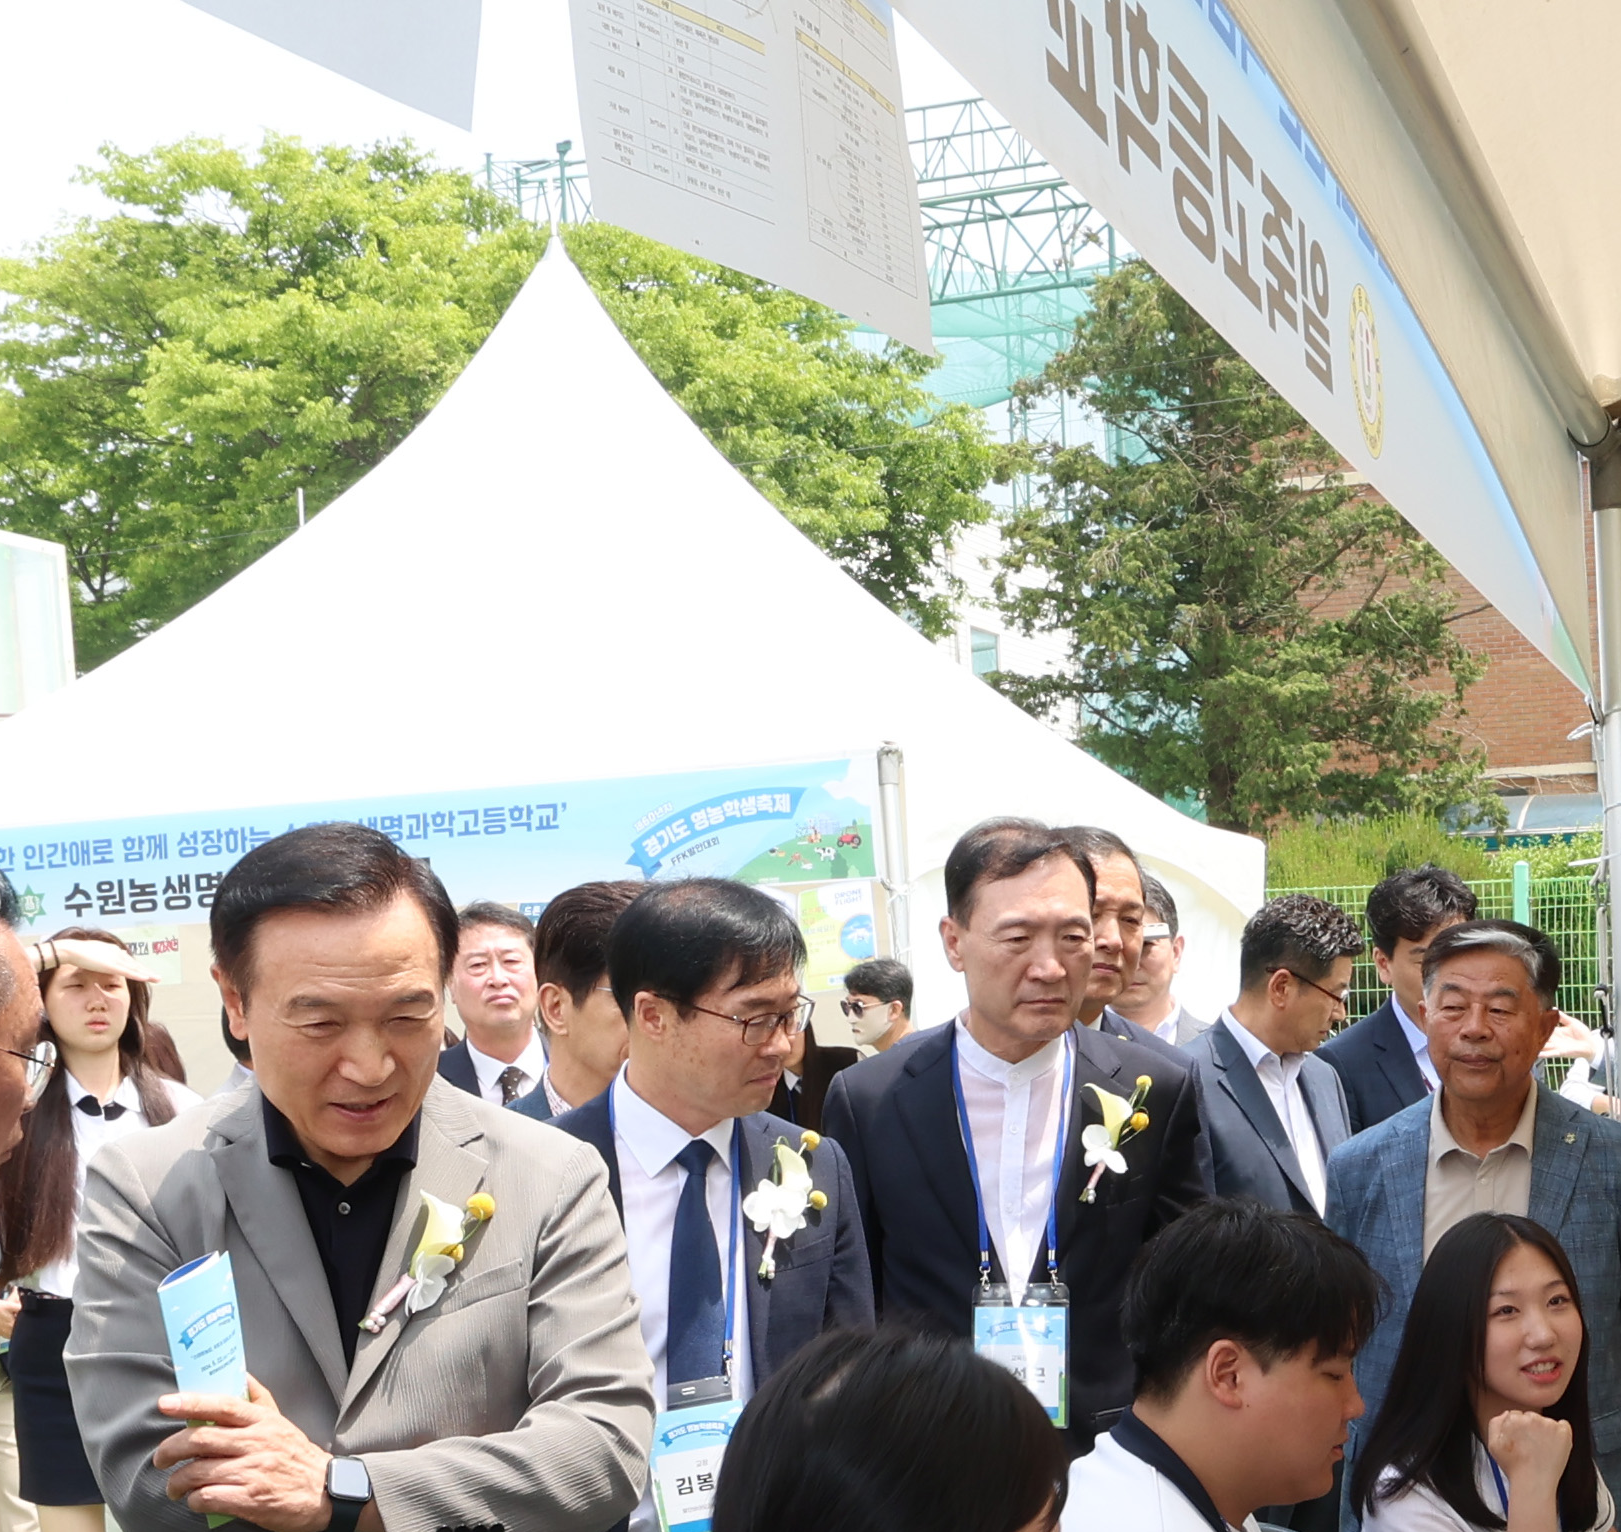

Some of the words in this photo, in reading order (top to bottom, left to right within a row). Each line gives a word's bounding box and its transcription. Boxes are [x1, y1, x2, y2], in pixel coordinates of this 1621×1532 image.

[23, 839, 114, 870] 인간애로
[122, 833, 168, 861] 함께
[176, 826, 272, 860] 성장하는
[642, 818, 692, 858] 경기도
[690, 793, 791, 831] 영농학생축제
